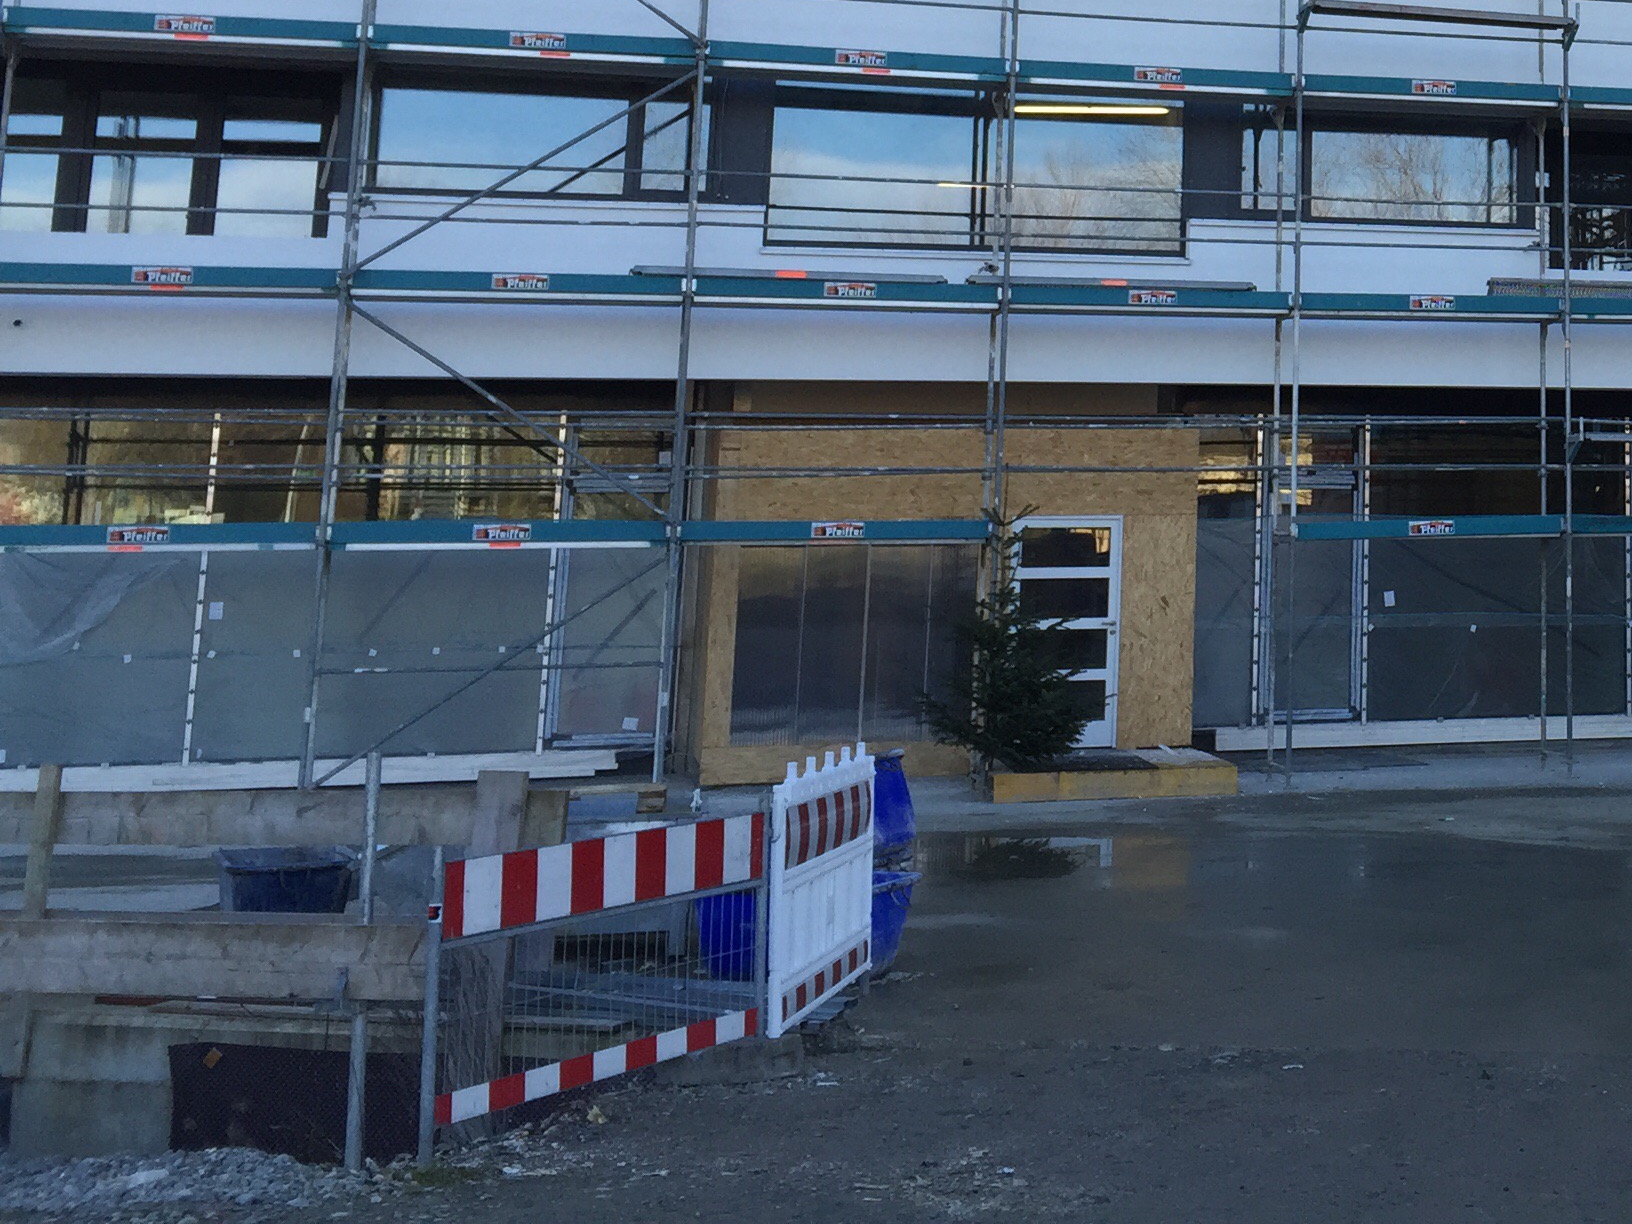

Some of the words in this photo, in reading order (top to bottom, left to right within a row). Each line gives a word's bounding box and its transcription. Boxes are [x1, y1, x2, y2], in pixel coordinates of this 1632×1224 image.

[170, 20, 214, 32] Pfeiffer
[523, 37, 565, 48] Pfeiffer
[849, 54, 886, 65] Pfeiffer
[148, 272, 191, 283] Pfeiffer
[507, 278, 547, 289] Pfeiffer
[838, 287, 875, 297] Pfeiffer
[123, 531, 168, 543] Pfeiffer
[488, 529, 529, 539] Pfeiffer
[826, 527, 864, 537] Pfeiffer
